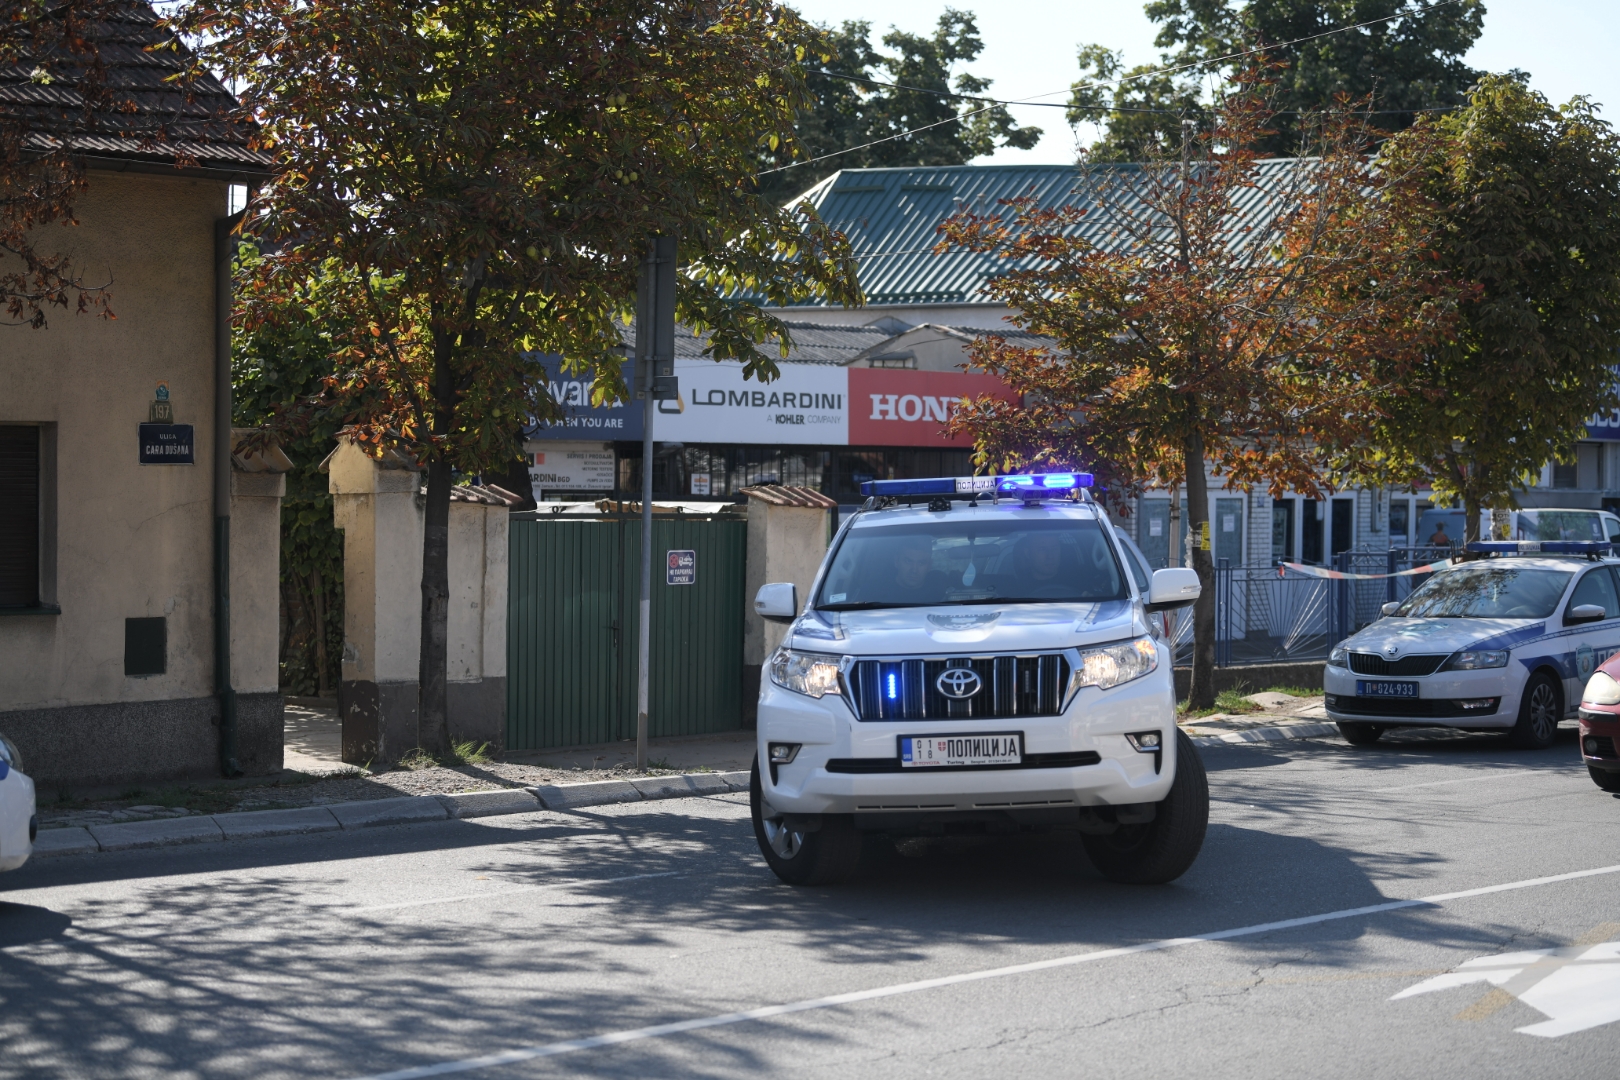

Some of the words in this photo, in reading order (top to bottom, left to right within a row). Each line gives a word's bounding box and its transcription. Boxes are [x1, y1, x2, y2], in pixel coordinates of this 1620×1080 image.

[692, 389, 842, 410] LOMBARDINI
[154, 405, 170, 419] 197
[581, 418, 602, 428] YOU
[604, 418, 624, 428] ARE
[766, 415, 773, 423] A
[775, 414, 805, 425] KOHLER
[807, 416, 841, 424] COMPANY
[146, 445, 164, 455] CARA
[165, 443, 189, 455] DUŠANA
[957, 480, 995, 490] ПОЛИЦИЈА
[947, 738, 1018, 758] ПОЛИЦИЈА
